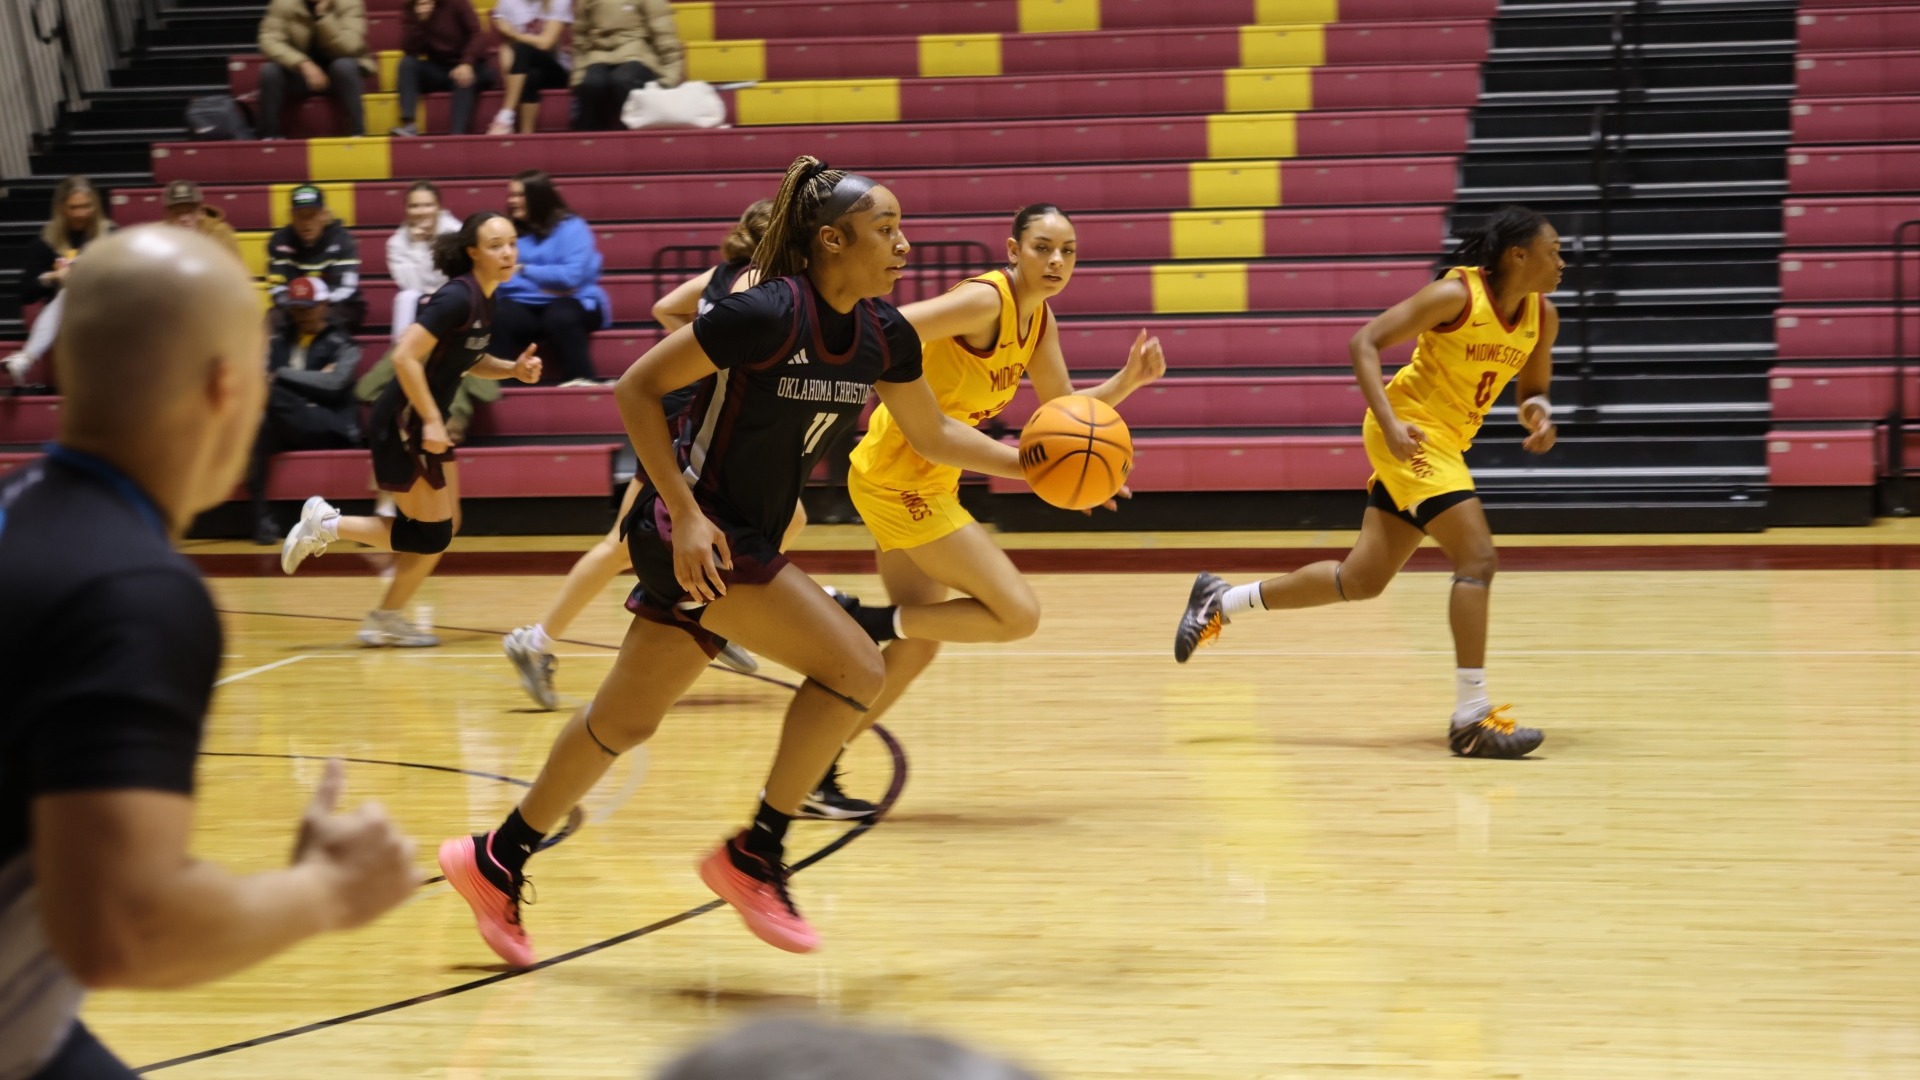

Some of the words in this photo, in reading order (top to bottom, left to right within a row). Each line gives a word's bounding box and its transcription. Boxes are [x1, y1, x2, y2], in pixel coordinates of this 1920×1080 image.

[777, 376, 832, 402] OKLAHOMA
[1474, 370, 1498, 408] 0
[801, 412, 839, 457] 11
